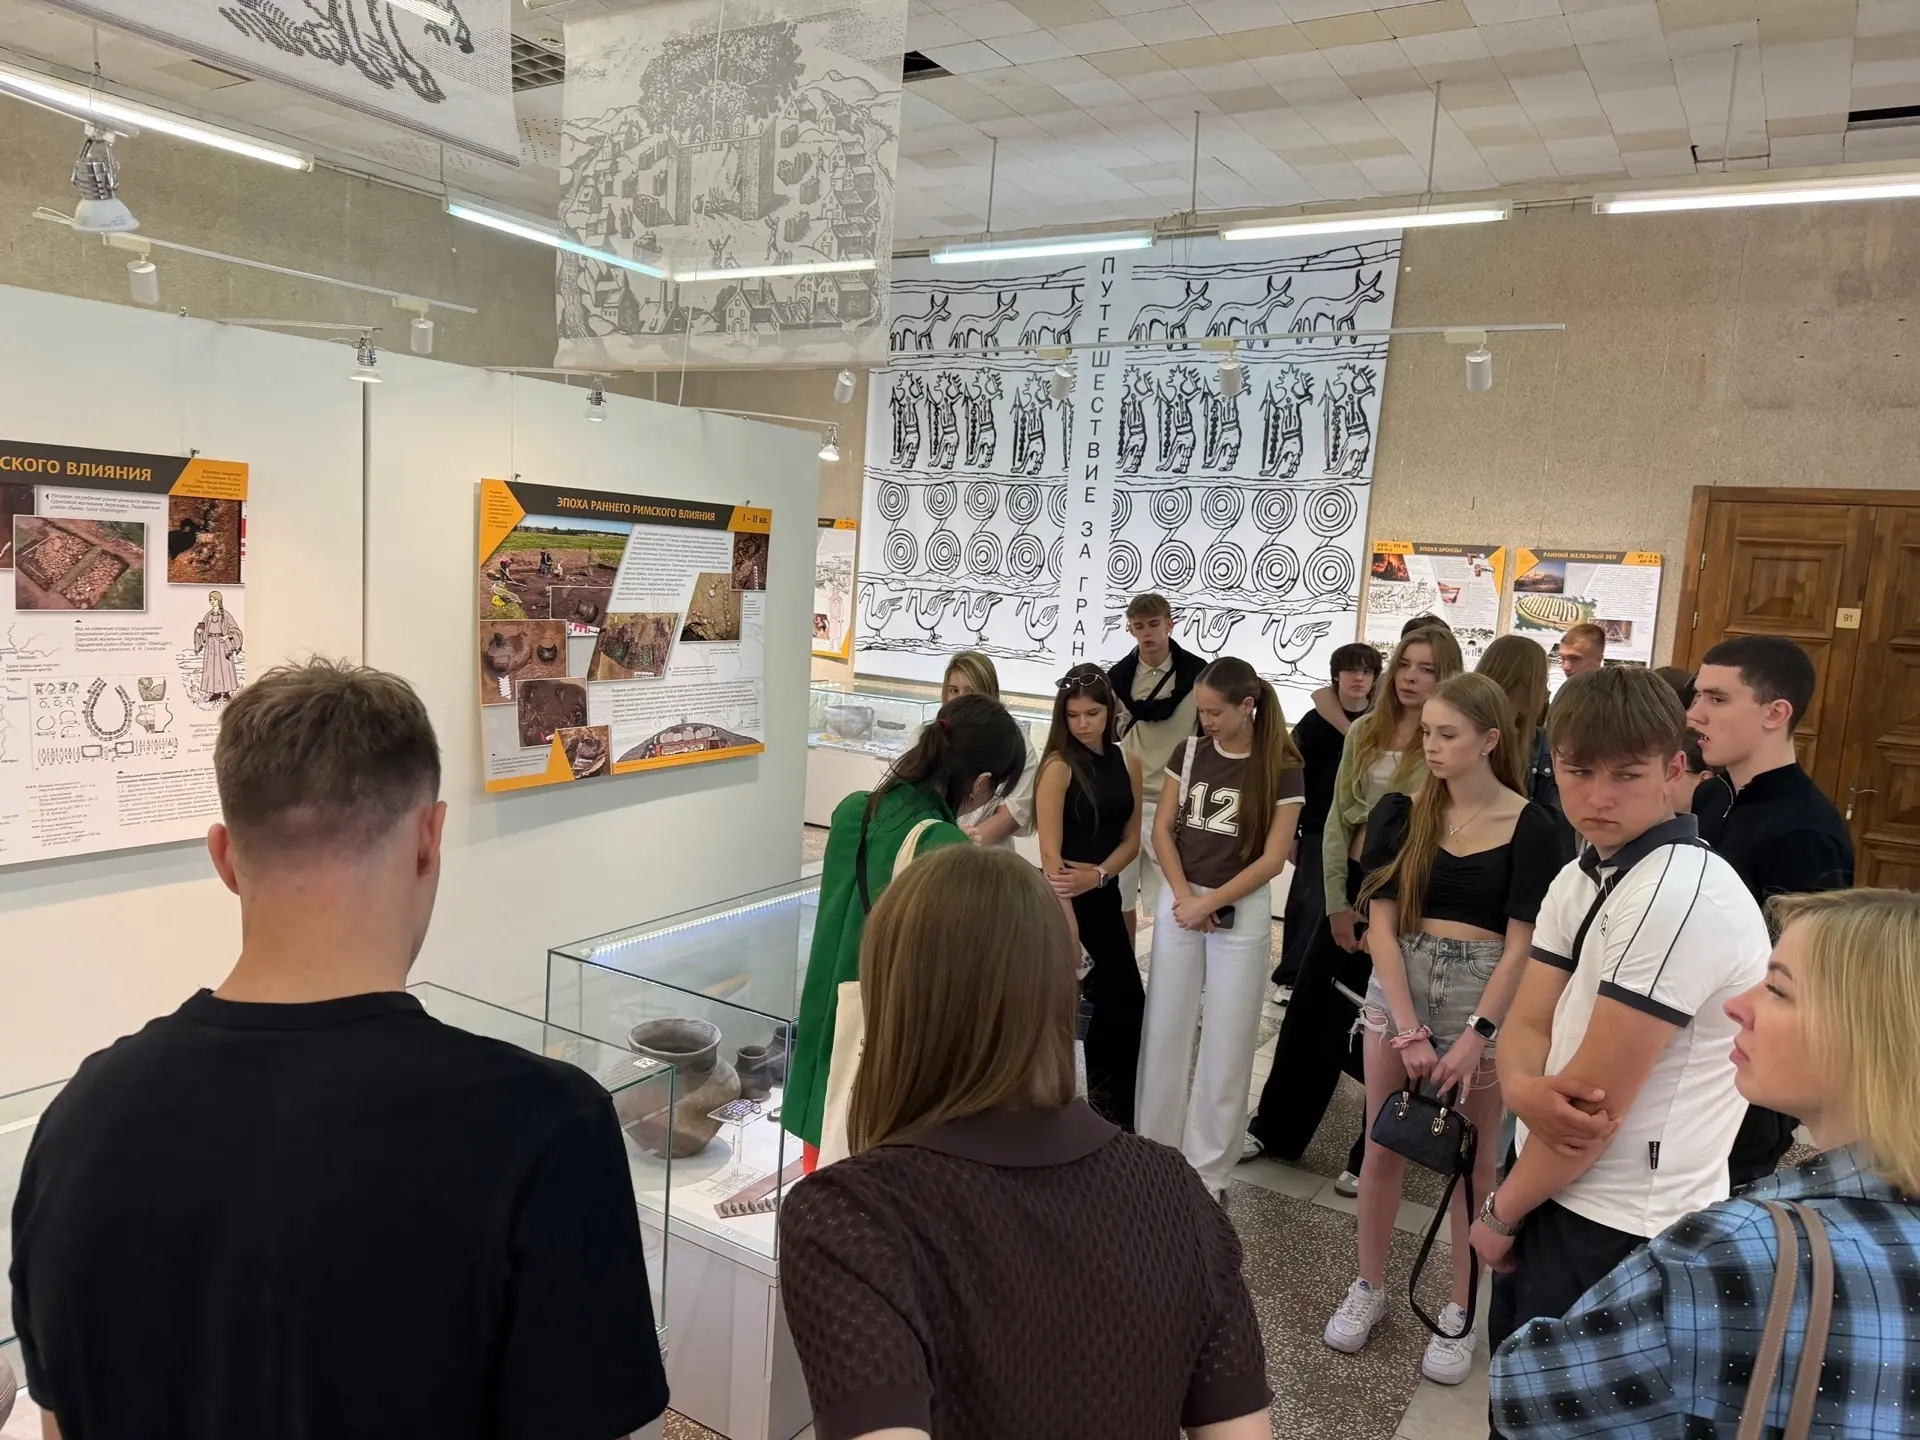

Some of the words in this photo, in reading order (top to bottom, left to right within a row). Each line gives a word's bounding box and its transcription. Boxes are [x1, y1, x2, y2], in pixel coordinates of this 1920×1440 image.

[0, 455, 61, 475] СКОГО
[66, 461, 152, 482] ВЛИЯНИЯ
[556, 496, 589, 510] ЭПОХА
[590, 500, 631, 514] РАННЕГО
[632, 504, 677, 518] РИМСКОГО
[678, 509, 716, 522] ВЛИЯНИЯ
[1543, 551, 1569, 559] РАННИЙ
[1570, 552, 1604, 560] ЖЕЛЕЗНЫЙ
[1072, 577, 1089, 668] ГРАН
[1843, 613, 1853, 622] 91
[1186, 781, 1241, 837] 12
